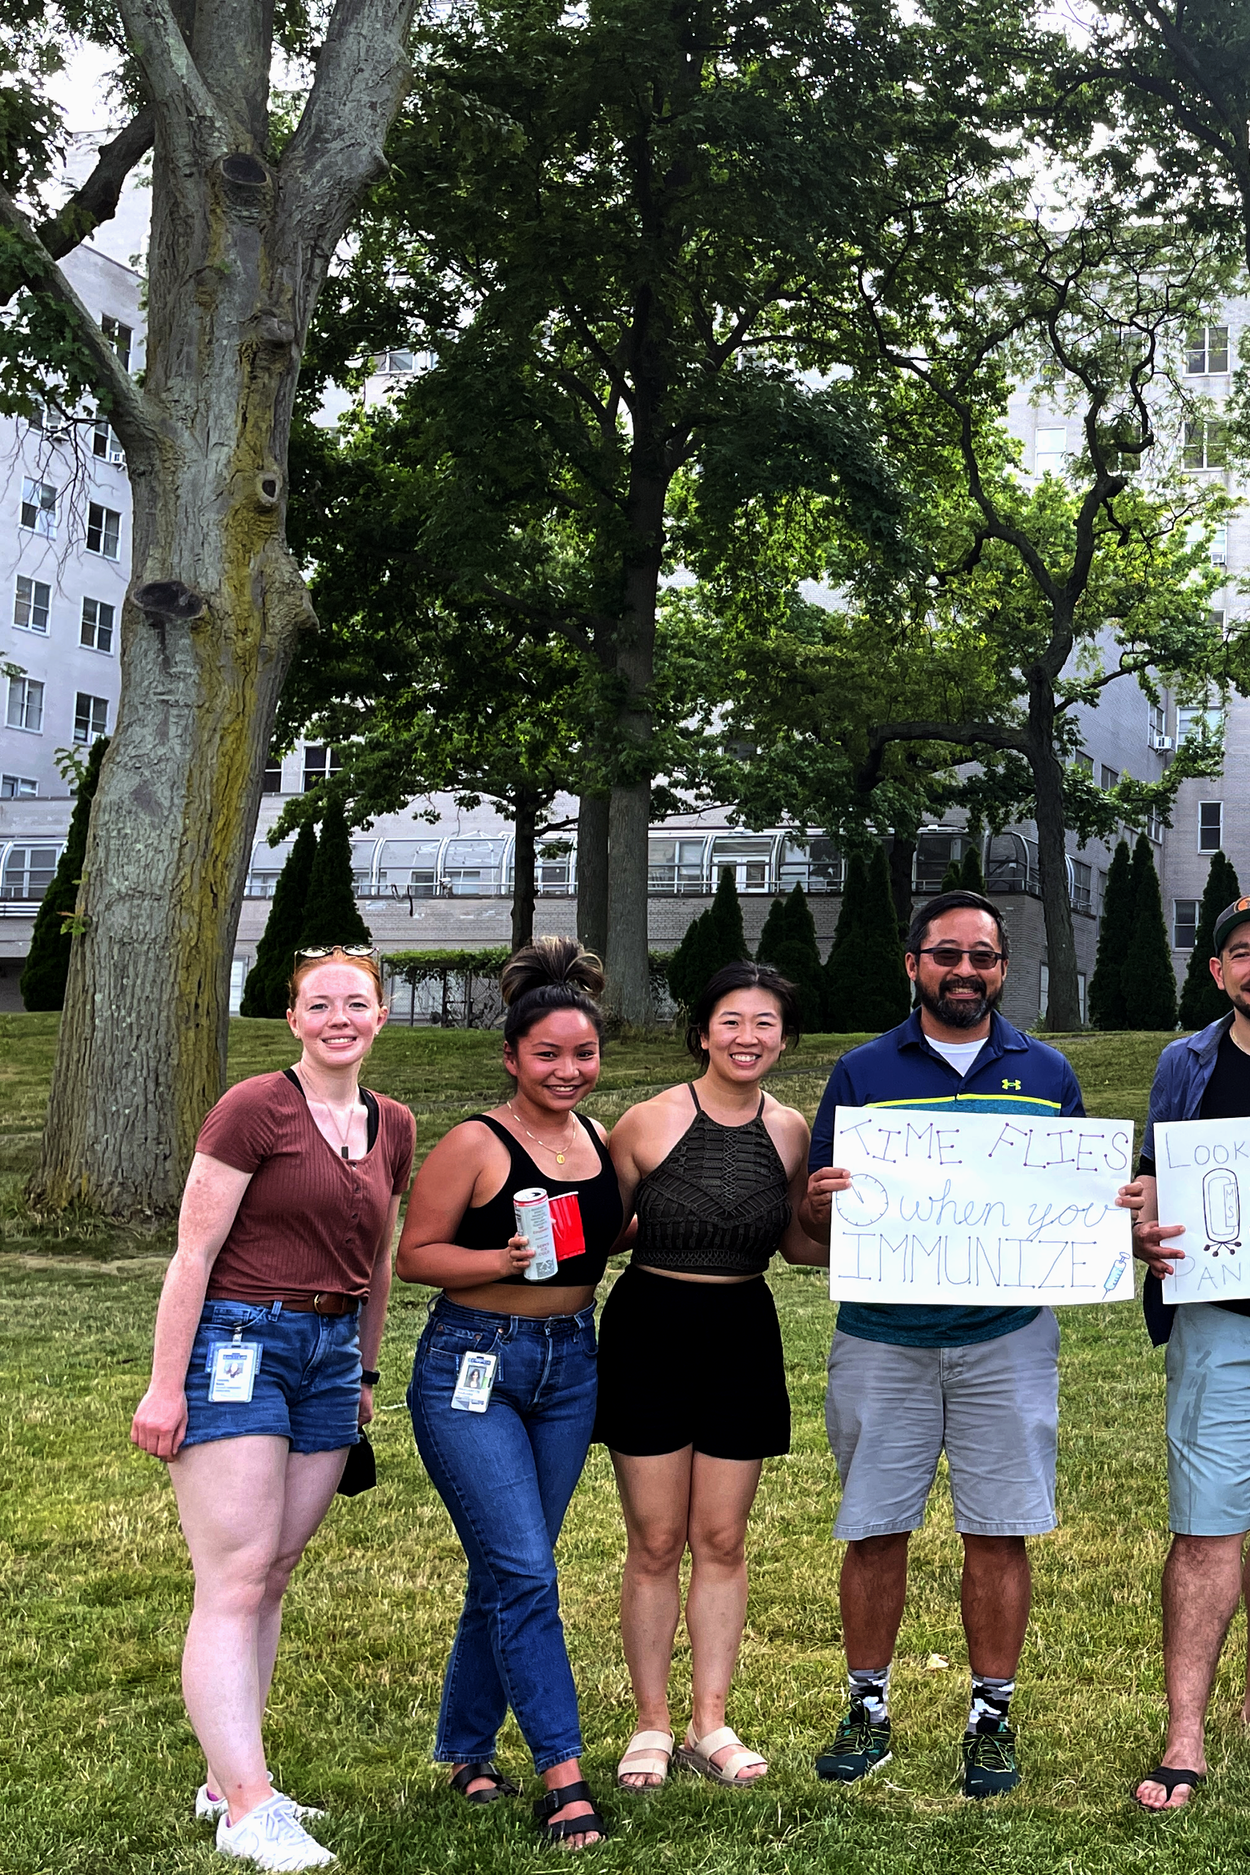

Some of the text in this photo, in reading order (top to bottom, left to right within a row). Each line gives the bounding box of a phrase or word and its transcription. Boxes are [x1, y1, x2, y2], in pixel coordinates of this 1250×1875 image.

[839, 1119, 1129, 1171] TIME FLIES
[900, 1178, 1122, 1242] when you
[838, 1231, 1097, 1289] IMMUNIZE
